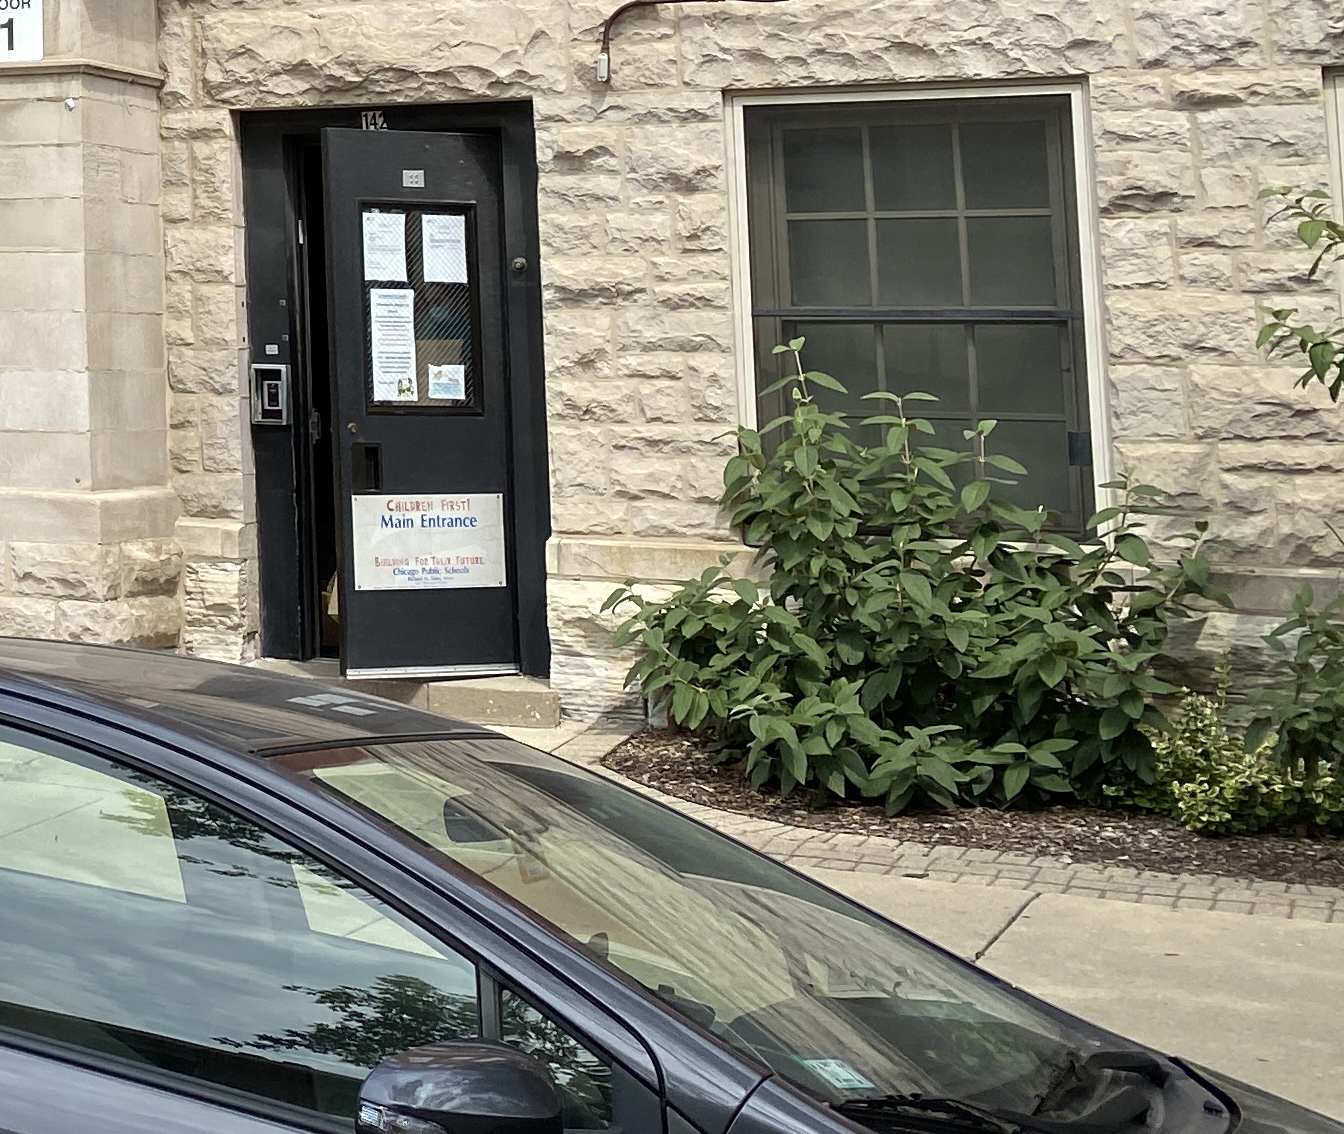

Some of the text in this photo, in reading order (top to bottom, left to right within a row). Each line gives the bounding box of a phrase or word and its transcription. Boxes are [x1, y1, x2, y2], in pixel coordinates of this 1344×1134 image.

[0, 17, 14, 51] 1
[362, 112, 389, 130] 142
[386, 499, 434, 512] CHILDREN
[380, 514, 478, 529] Main Entrance
[421, 567, 440, 575] Public
[445, 566, 470, 575] Schools
